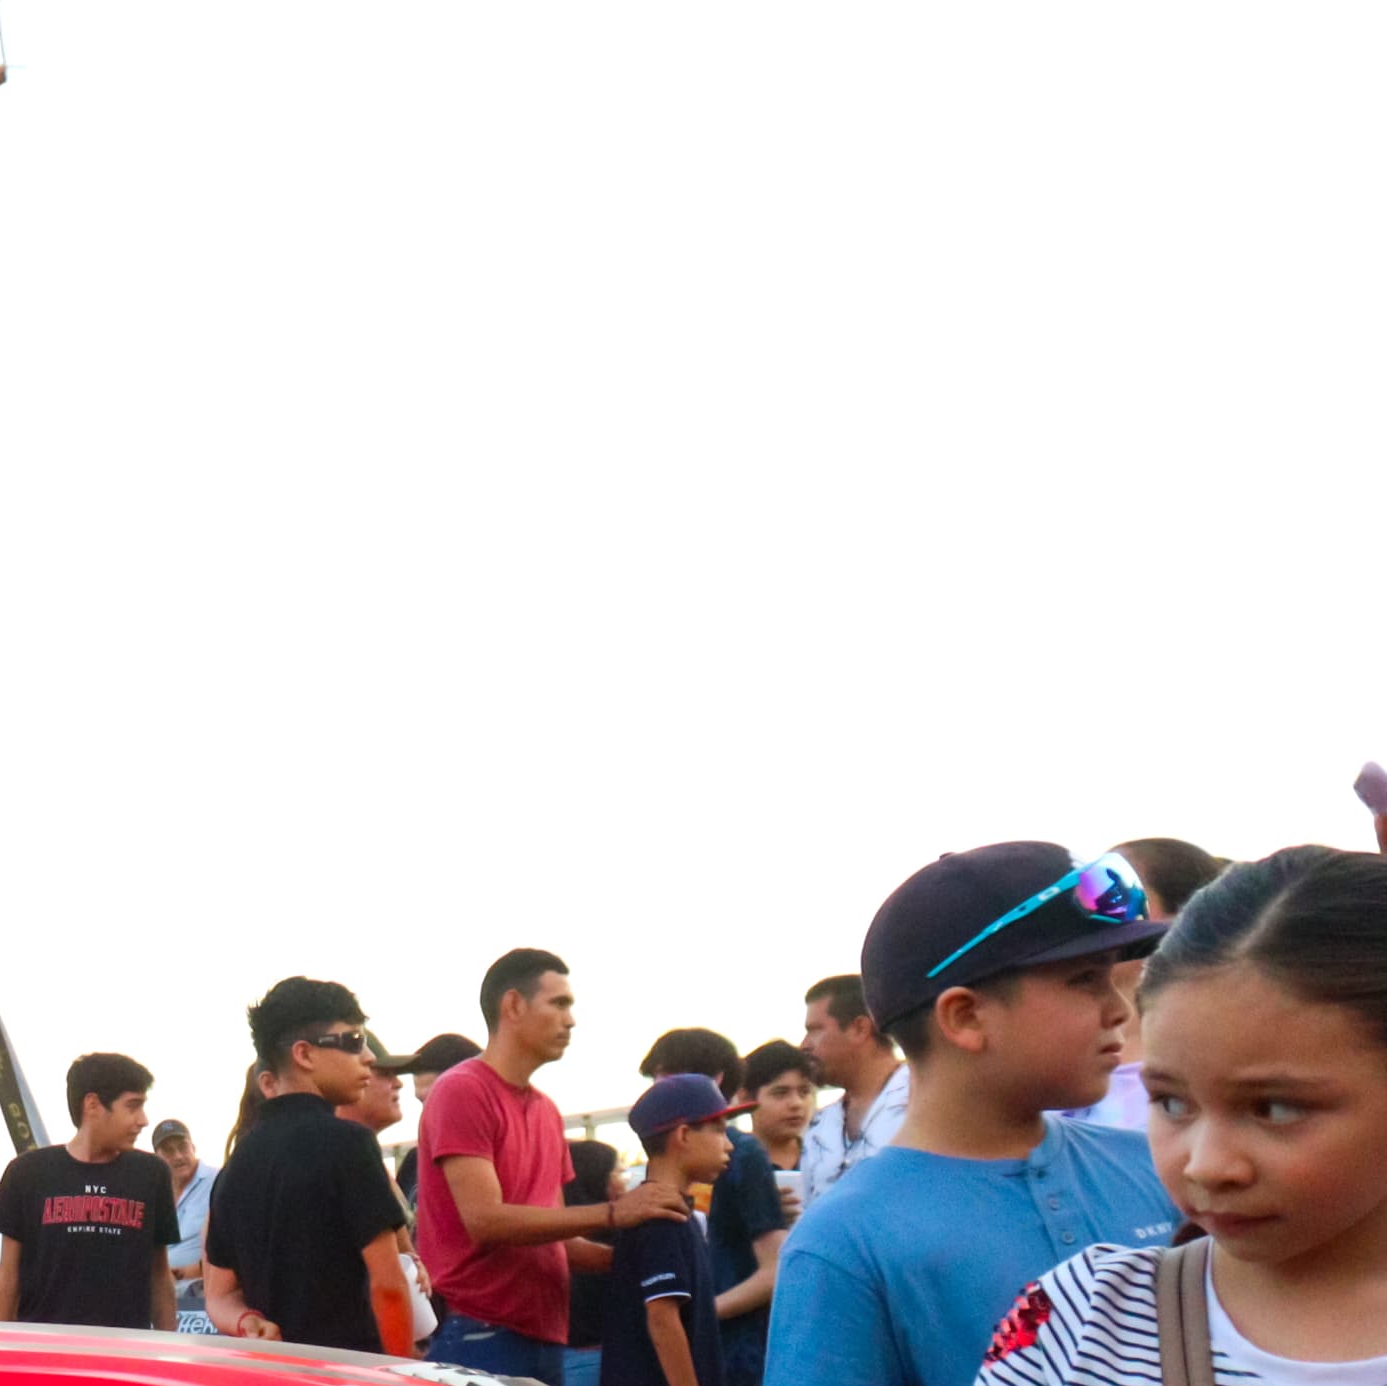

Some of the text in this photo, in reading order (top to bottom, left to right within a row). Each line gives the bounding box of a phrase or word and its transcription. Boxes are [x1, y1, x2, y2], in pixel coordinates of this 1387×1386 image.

[84, 1184, 107, 1194] NYC
[67, 1225, 122, 1236] EMPIRE STATE
